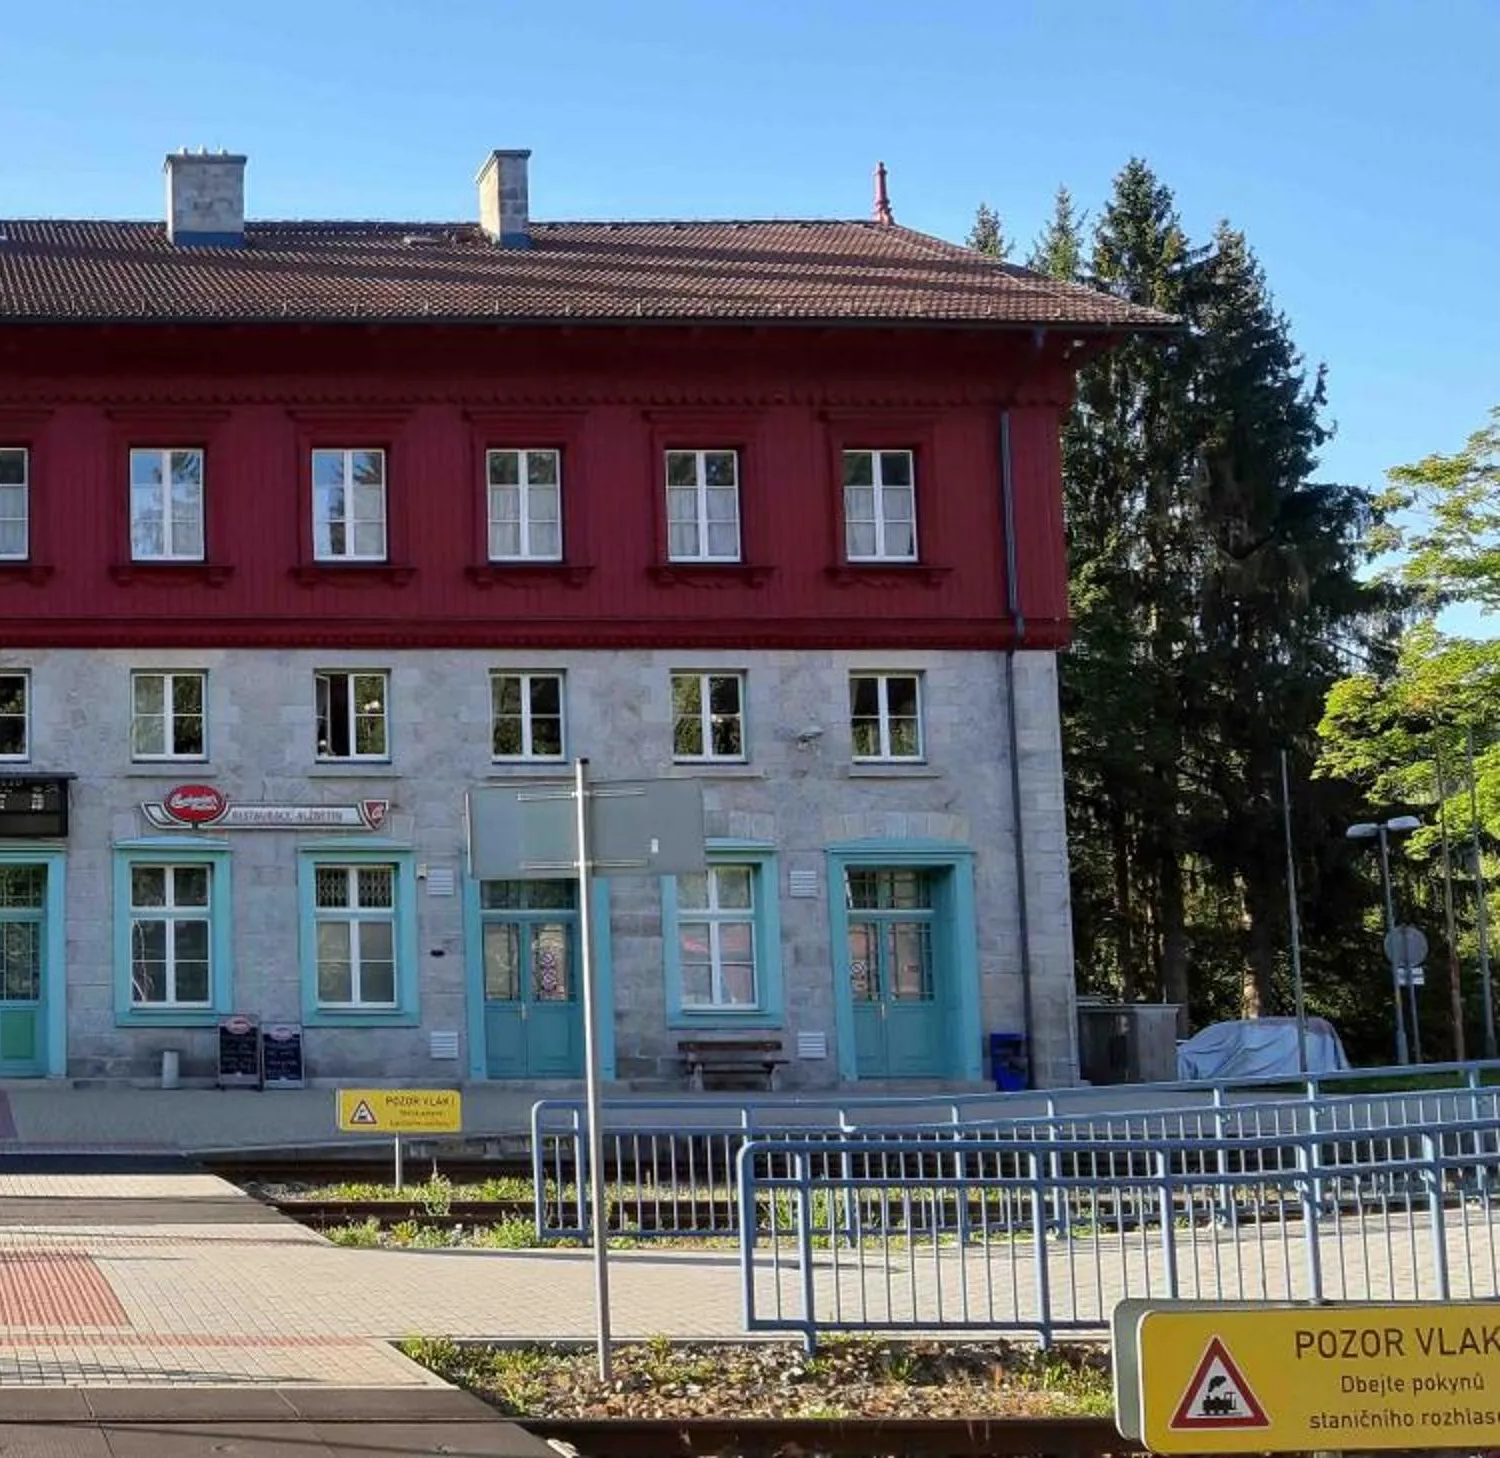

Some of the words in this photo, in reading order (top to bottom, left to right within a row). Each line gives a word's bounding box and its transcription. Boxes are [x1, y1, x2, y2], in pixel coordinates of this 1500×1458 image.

[1295, 1327, 1405, 1360] POZOR
[1341, 1373, 1405, 1398] Dbejte
[1412, 1371, 1485, 1397] pokynů
[1309, 1408, 1415, 1429] staničního
[1420, 1407, 1500, 1427] rozhlas
